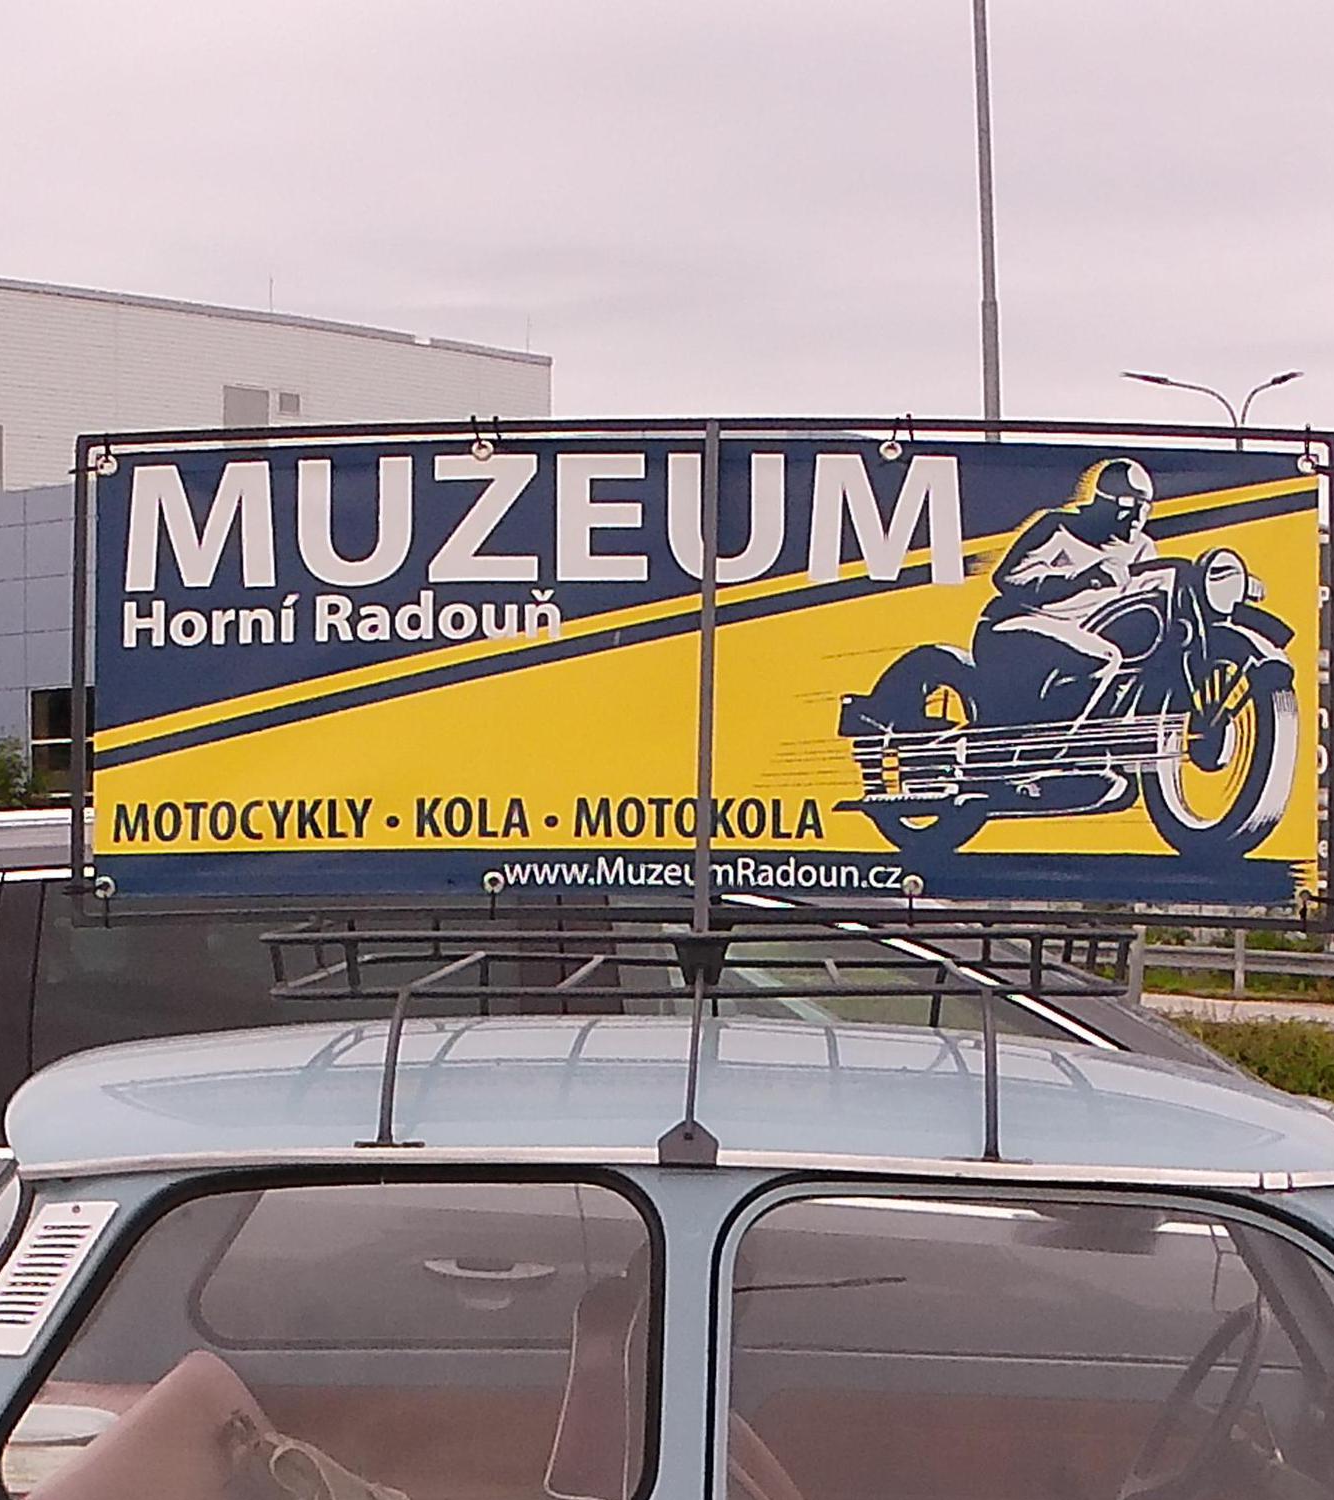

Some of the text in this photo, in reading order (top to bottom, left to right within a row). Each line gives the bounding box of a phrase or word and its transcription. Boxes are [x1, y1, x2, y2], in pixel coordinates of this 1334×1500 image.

[124, 453, 965, 592] MUZEUM
[123, 588, 562, 648] Horní Radouň
[113, 797, 824, 843] MOTOCYKLY KOLA MOTOKOLA
[503, 856, 903, 888] www.MuzeumRadoun.cz
